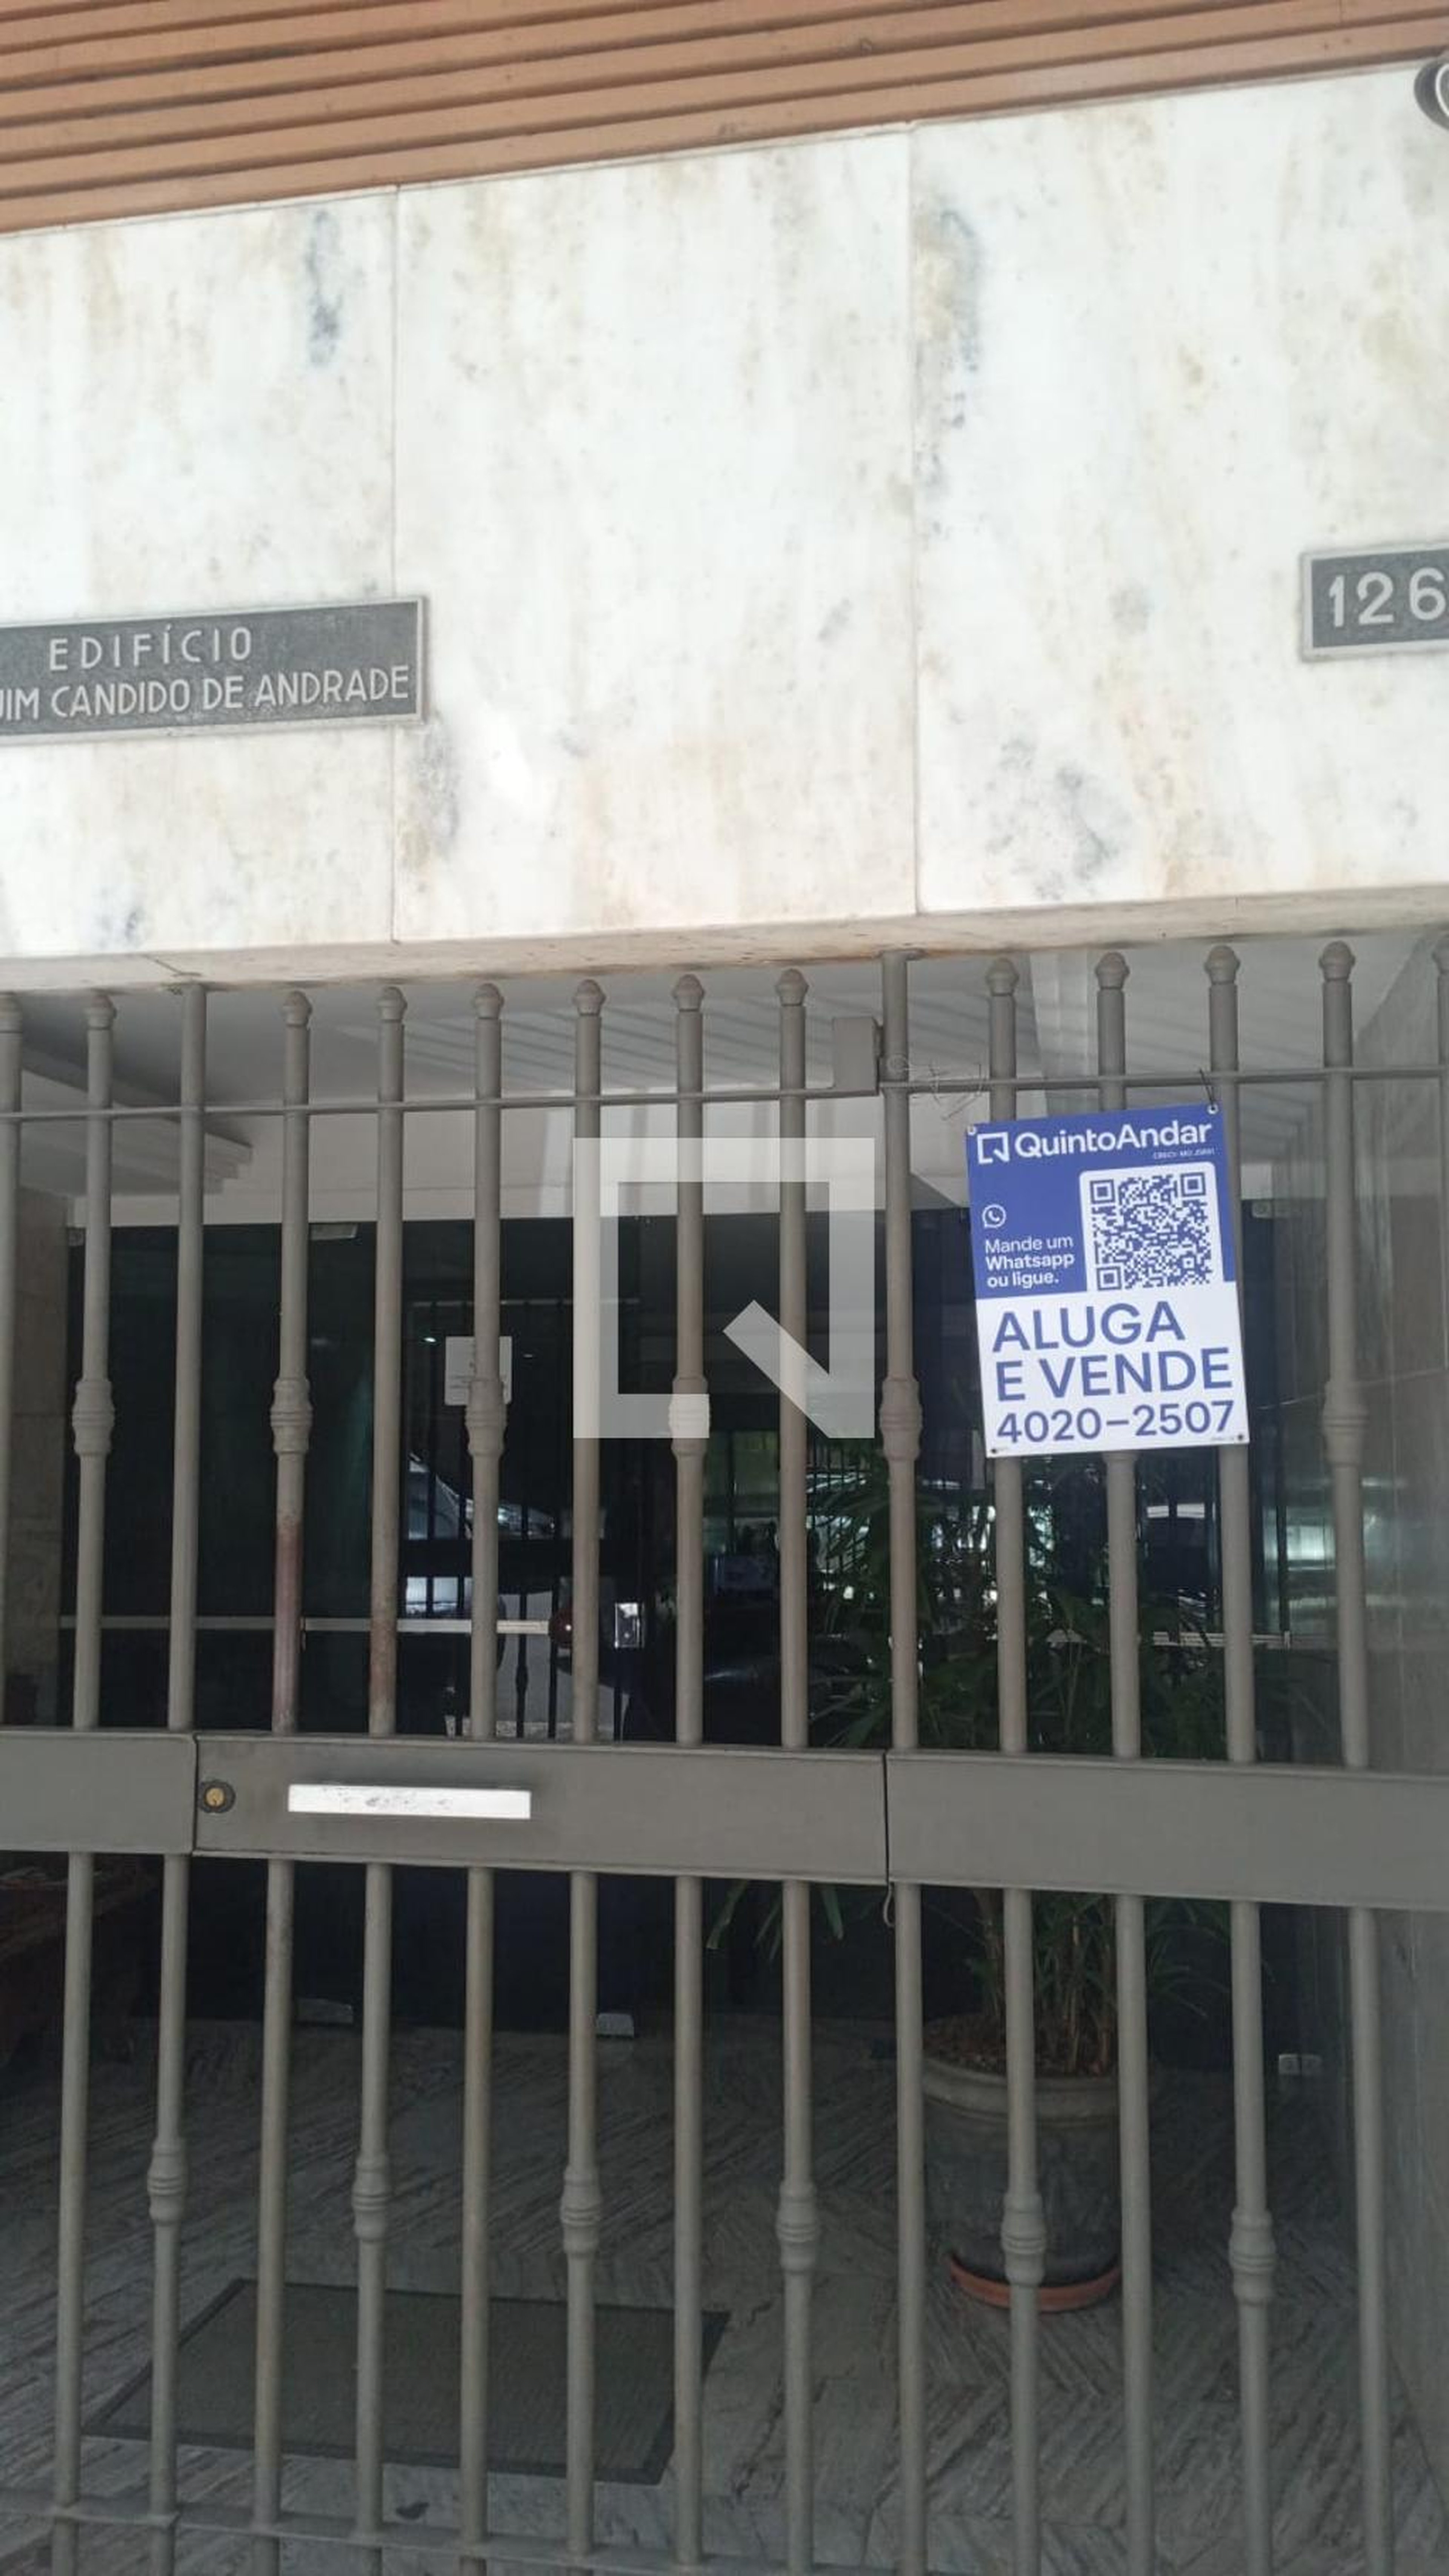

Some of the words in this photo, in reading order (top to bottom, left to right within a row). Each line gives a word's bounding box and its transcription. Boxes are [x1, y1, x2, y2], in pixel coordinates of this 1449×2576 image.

[1329, 567, 1446, 627] 126
[48, 625, 252, 672] EDIFÍCIO
[0, 687, 39, 720] IM
[51, 680, 191, 718] CANDIDO
[203, 676, 244, 710] DE
[255, 666, 409, 707] ANDRADE
[1014, 1120, 1212, 1158] QuintoAndar
[986, 1236, 1042, 1254] Mande
[1047, 1235, 1073, 1249] um
[986, 1252, 1075, 1271] Whatsapp
[987, 1273, 1008, 1288] ou
[1012, 1270, 1060, 1288] ligue.
[992, 1301, 1185, 1352] ALUGA
[996, 1360, 1026, 1401] E
[1039, 1347, 1232, 1398] VENDE
[997, 1400, 1234, 1443] 4020-2507
